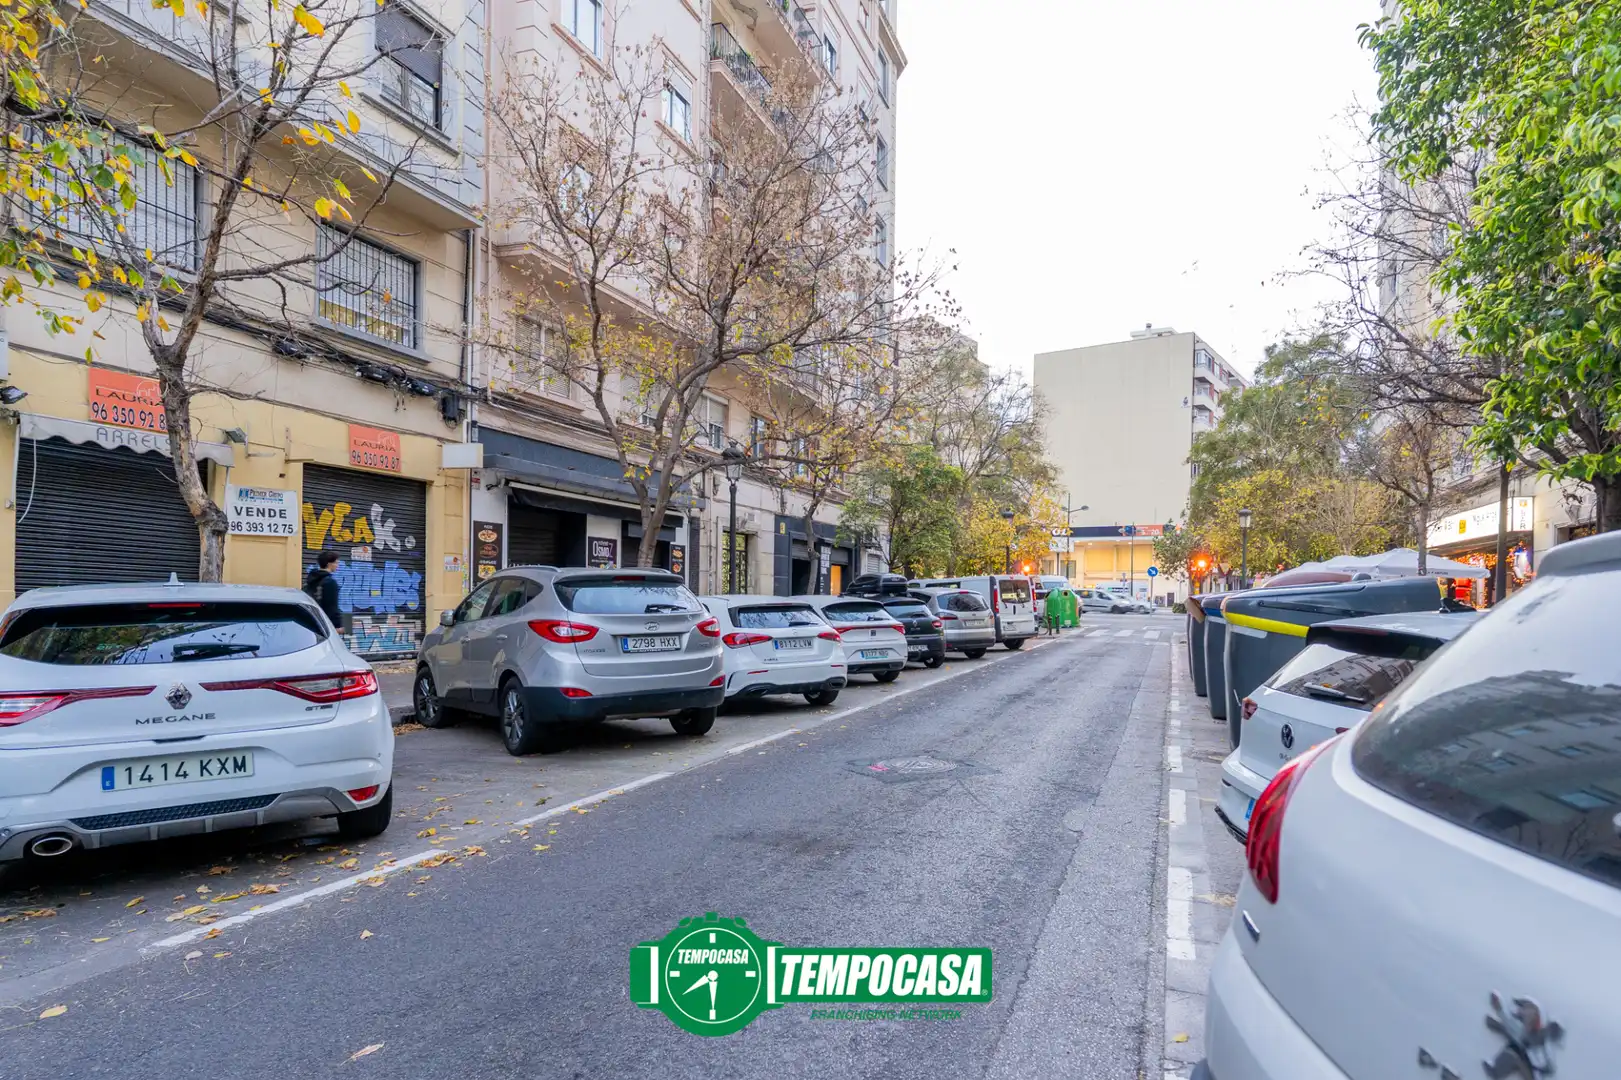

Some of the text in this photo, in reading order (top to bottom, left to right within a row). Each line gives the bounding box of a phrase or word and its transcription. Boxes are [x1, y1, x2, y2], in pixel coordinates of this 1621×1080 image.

[91, 401, 167, 431] 96 350 92 8
[352, 449, 362, 464] 96
[364, 451, 377, 467] 350
[391, 456, 400, 470] 87
[234, 505, 288, 519] VENDE
[230, 520, 294, 534] 96 393 12 75
[631, 637, 677, 649] 2798 HXX
[135, 712, 216, 726] MEGANE
[124, 754, 248, 786] 1414 KXM
